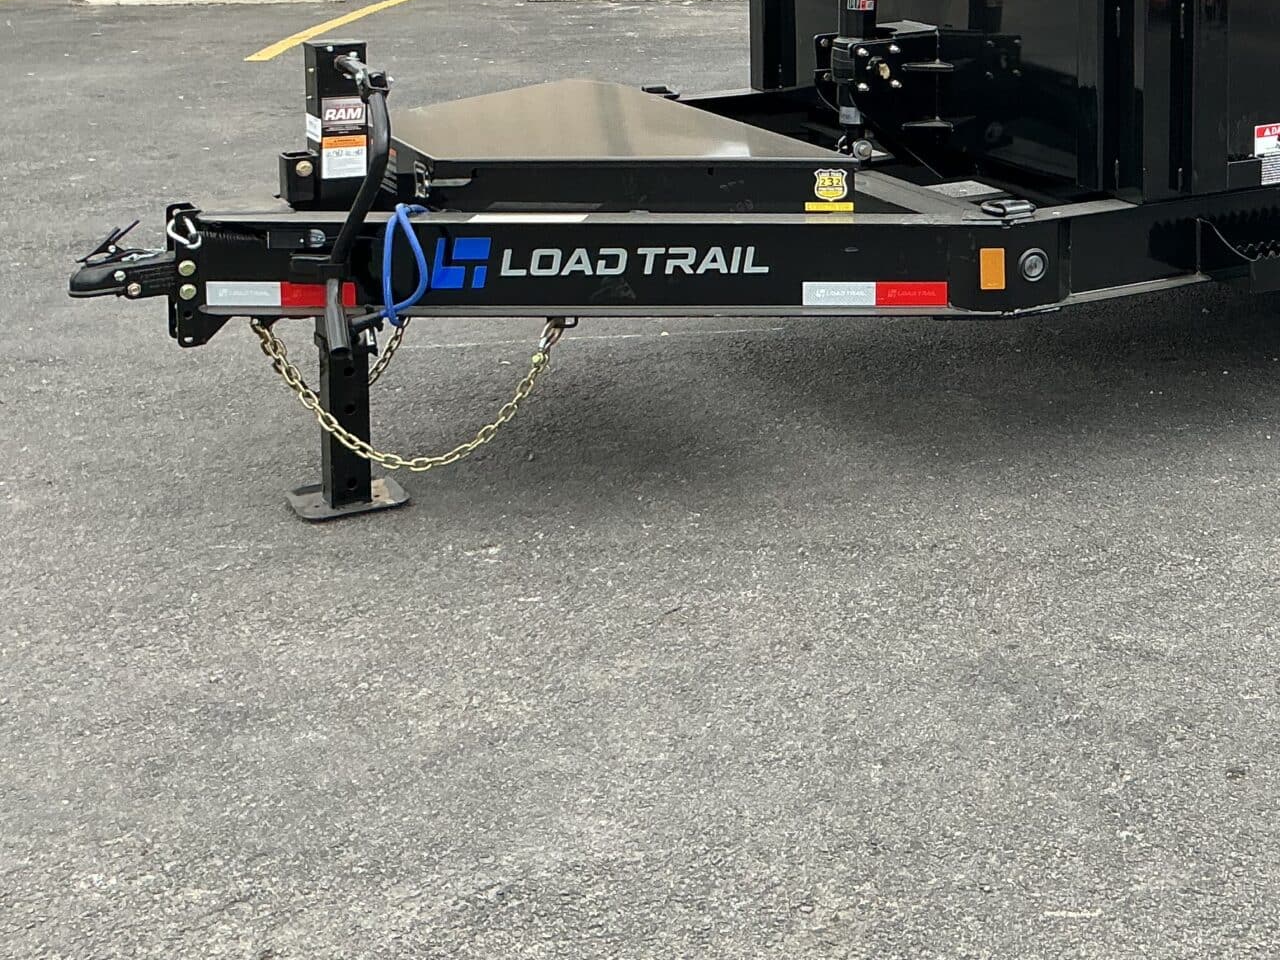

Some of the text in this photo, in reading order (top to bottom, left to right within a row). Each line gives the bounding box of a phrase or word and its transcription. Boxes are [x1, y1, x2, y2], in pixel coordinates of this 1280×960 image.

[325, 108, 362, 121] RAM
[821, 178, 841, 187] 232
[500, 248, 628, 277] LOAD
[637, 246, 769, 275] TRAIL
